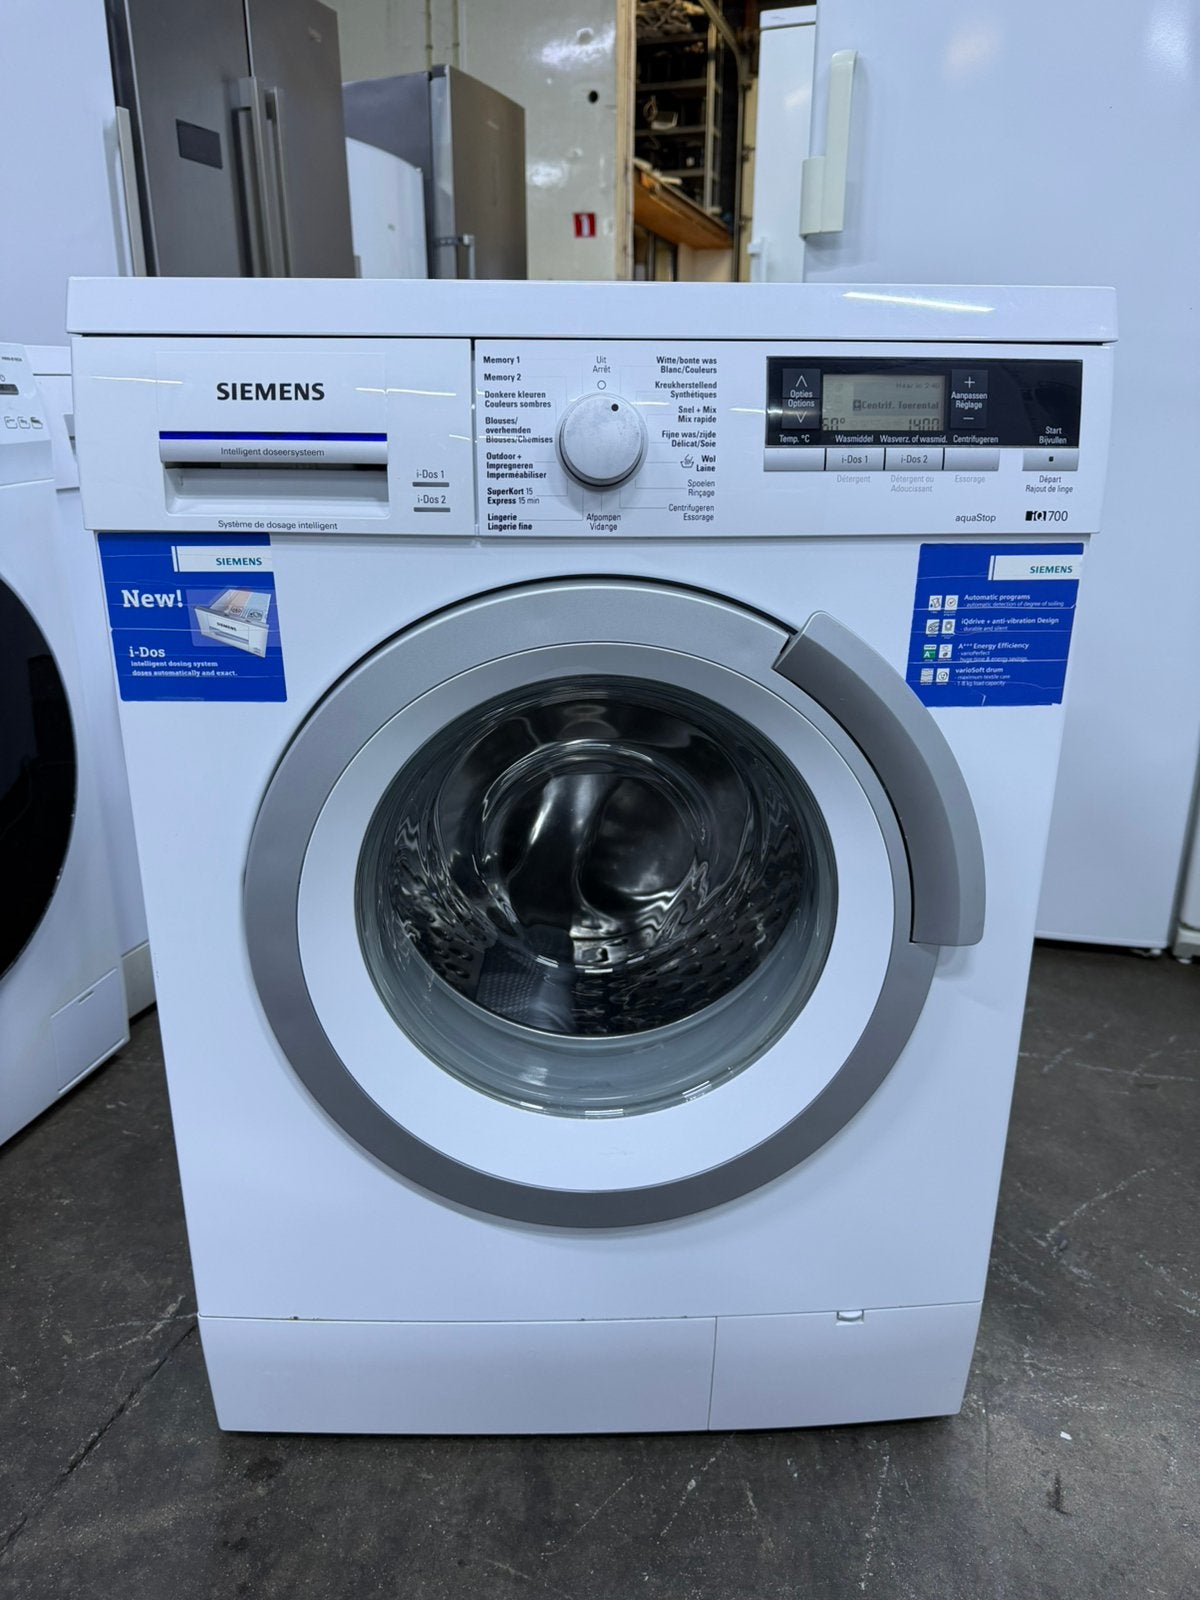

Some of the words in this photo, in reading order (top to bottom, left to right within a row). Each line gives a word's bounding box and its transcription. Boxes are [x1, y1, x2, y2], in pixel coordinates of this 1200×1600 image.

[483, 356, 515, 365] Memory
[516, 356, 520, 364] 1
[596, 355, 607, 364] Uit
[656, 356, 700, 365] Witte/bonte
[592, 365, 611, 374] Arrêt
[660, 365, 717, 374] Blanc/Couleurs
[484, 373, 515, 382] Memory
[516, 373, 522, 381] 2
[654, 381, 718, 389] Kreukherstellend
[216, 382, 326, 401] SIEMENS
[484, 391, 516, 399] Donkere
[517, 391, 546, 399] kleuren
[670, 390, 717, 399] Synthétiques
[790, 390, 813, 398] Opties
[951, 391, 988, 400] Aanpassen
[484, 400, 518, 408] Couleurs
[519, 400, 552, 408] sombres
[788, 399, 815, 408] Options
[955, 400, 983, 410] Réglage
[678, 406, 695, 414] Snel
[702, 406, 717, 414] Mix
[485, 416, 519, 425] Blouses/
[677, 415, 692, 423] Mix
[693, 415, 717, 424] rapide
[485, 426, 532, 434] overhemden
[1045, 426, 1062, 434] Start
[485, 434, 554, 444] Blouses/Chemises
[661, 430, 680, 439] Fijne
[681, 430, 717, 440] was/zijde
[779, 435, 799, 444] Temp.
[835, 434, 874, 443] Wasmiddel
[880, 434, 911, 443] Wasverz.
[911, 435, 920, 443] of
[919, 435, 948, 443] wasmid.
[953, 435, 999, 444] Centrifugeren
[671, 440, 717, 448] Délicat/Soie
[1039, 436, 1067, 445] Bijvullen
[220, 447, 262, 457] Intelligent
[262, 448, 325, 457] doseersysteem
[486, 452, 516, 460] Outdoor
[701, 455, 717, 463] Wol
[841, 455, 863, 464] i-Dos
[864, 455, 868, 463] 1
[900, 455, 921, 464] i-Dos
[922, 455, 928, 463] 2
[486, 462, 534, 470] Impregneren
[416, 469, 438, 479] i-Dos
[440, 470, 445, 479] 1
[486, 471, 547, 480] Imperméabiliser
[687, 479, 716, 487] Spoelen
[836, 475, 871, 484] Détergent
[890, 475, 924, 484] Détergent
[954, 475, 986, 484] Essorage
[1039, 475, 1062, 484] Départ
[487, 488, 524, 497] SuperKort
[687, 489, 715, 498] Rinçage
[890, 485, 933, 493] Adoucissant
[1025, 485, 1047, 494] Rajout
[1057, 485, 1073, 494] linge
[417, 494, 440, 504] i-Dos
[441, 495, 447, 504] 2
[487, 497, 517, 506] Express
[668, 504, 715, 513] Centrifugeren
[487, 513, 517, 522] Lingerie
[586, 513, 622, 522] Afpompen
[683, 513, 714, 522] Essorage
[955, 513, 997, 523] aquaStop
[218, 520, 253, 529] Système
[254, 520, 265, 528] de
[266, 521, 296, 530] dosage
[297, 521, 338, 531] intelligent
[487, 523, 517, 532] Lingerie
[518, 523, 533, 531] fine
[589, 522, 618, 532] Vidange
[215, 557, 263, 566] SIEMENS
[1029, 565, 1073, 574] SIEMENS
[121, 589, 184, 608] New!
[999, 594, 1031, 602] programs
[991, 617, 1036, 625] anti-vibration
[1036, 616, 1059, 625] Design
[973, 643, 997, 651] Energy
[997, 642, 1030, 650] Efficiency
[129, 646, 166, 658] i-Dos
